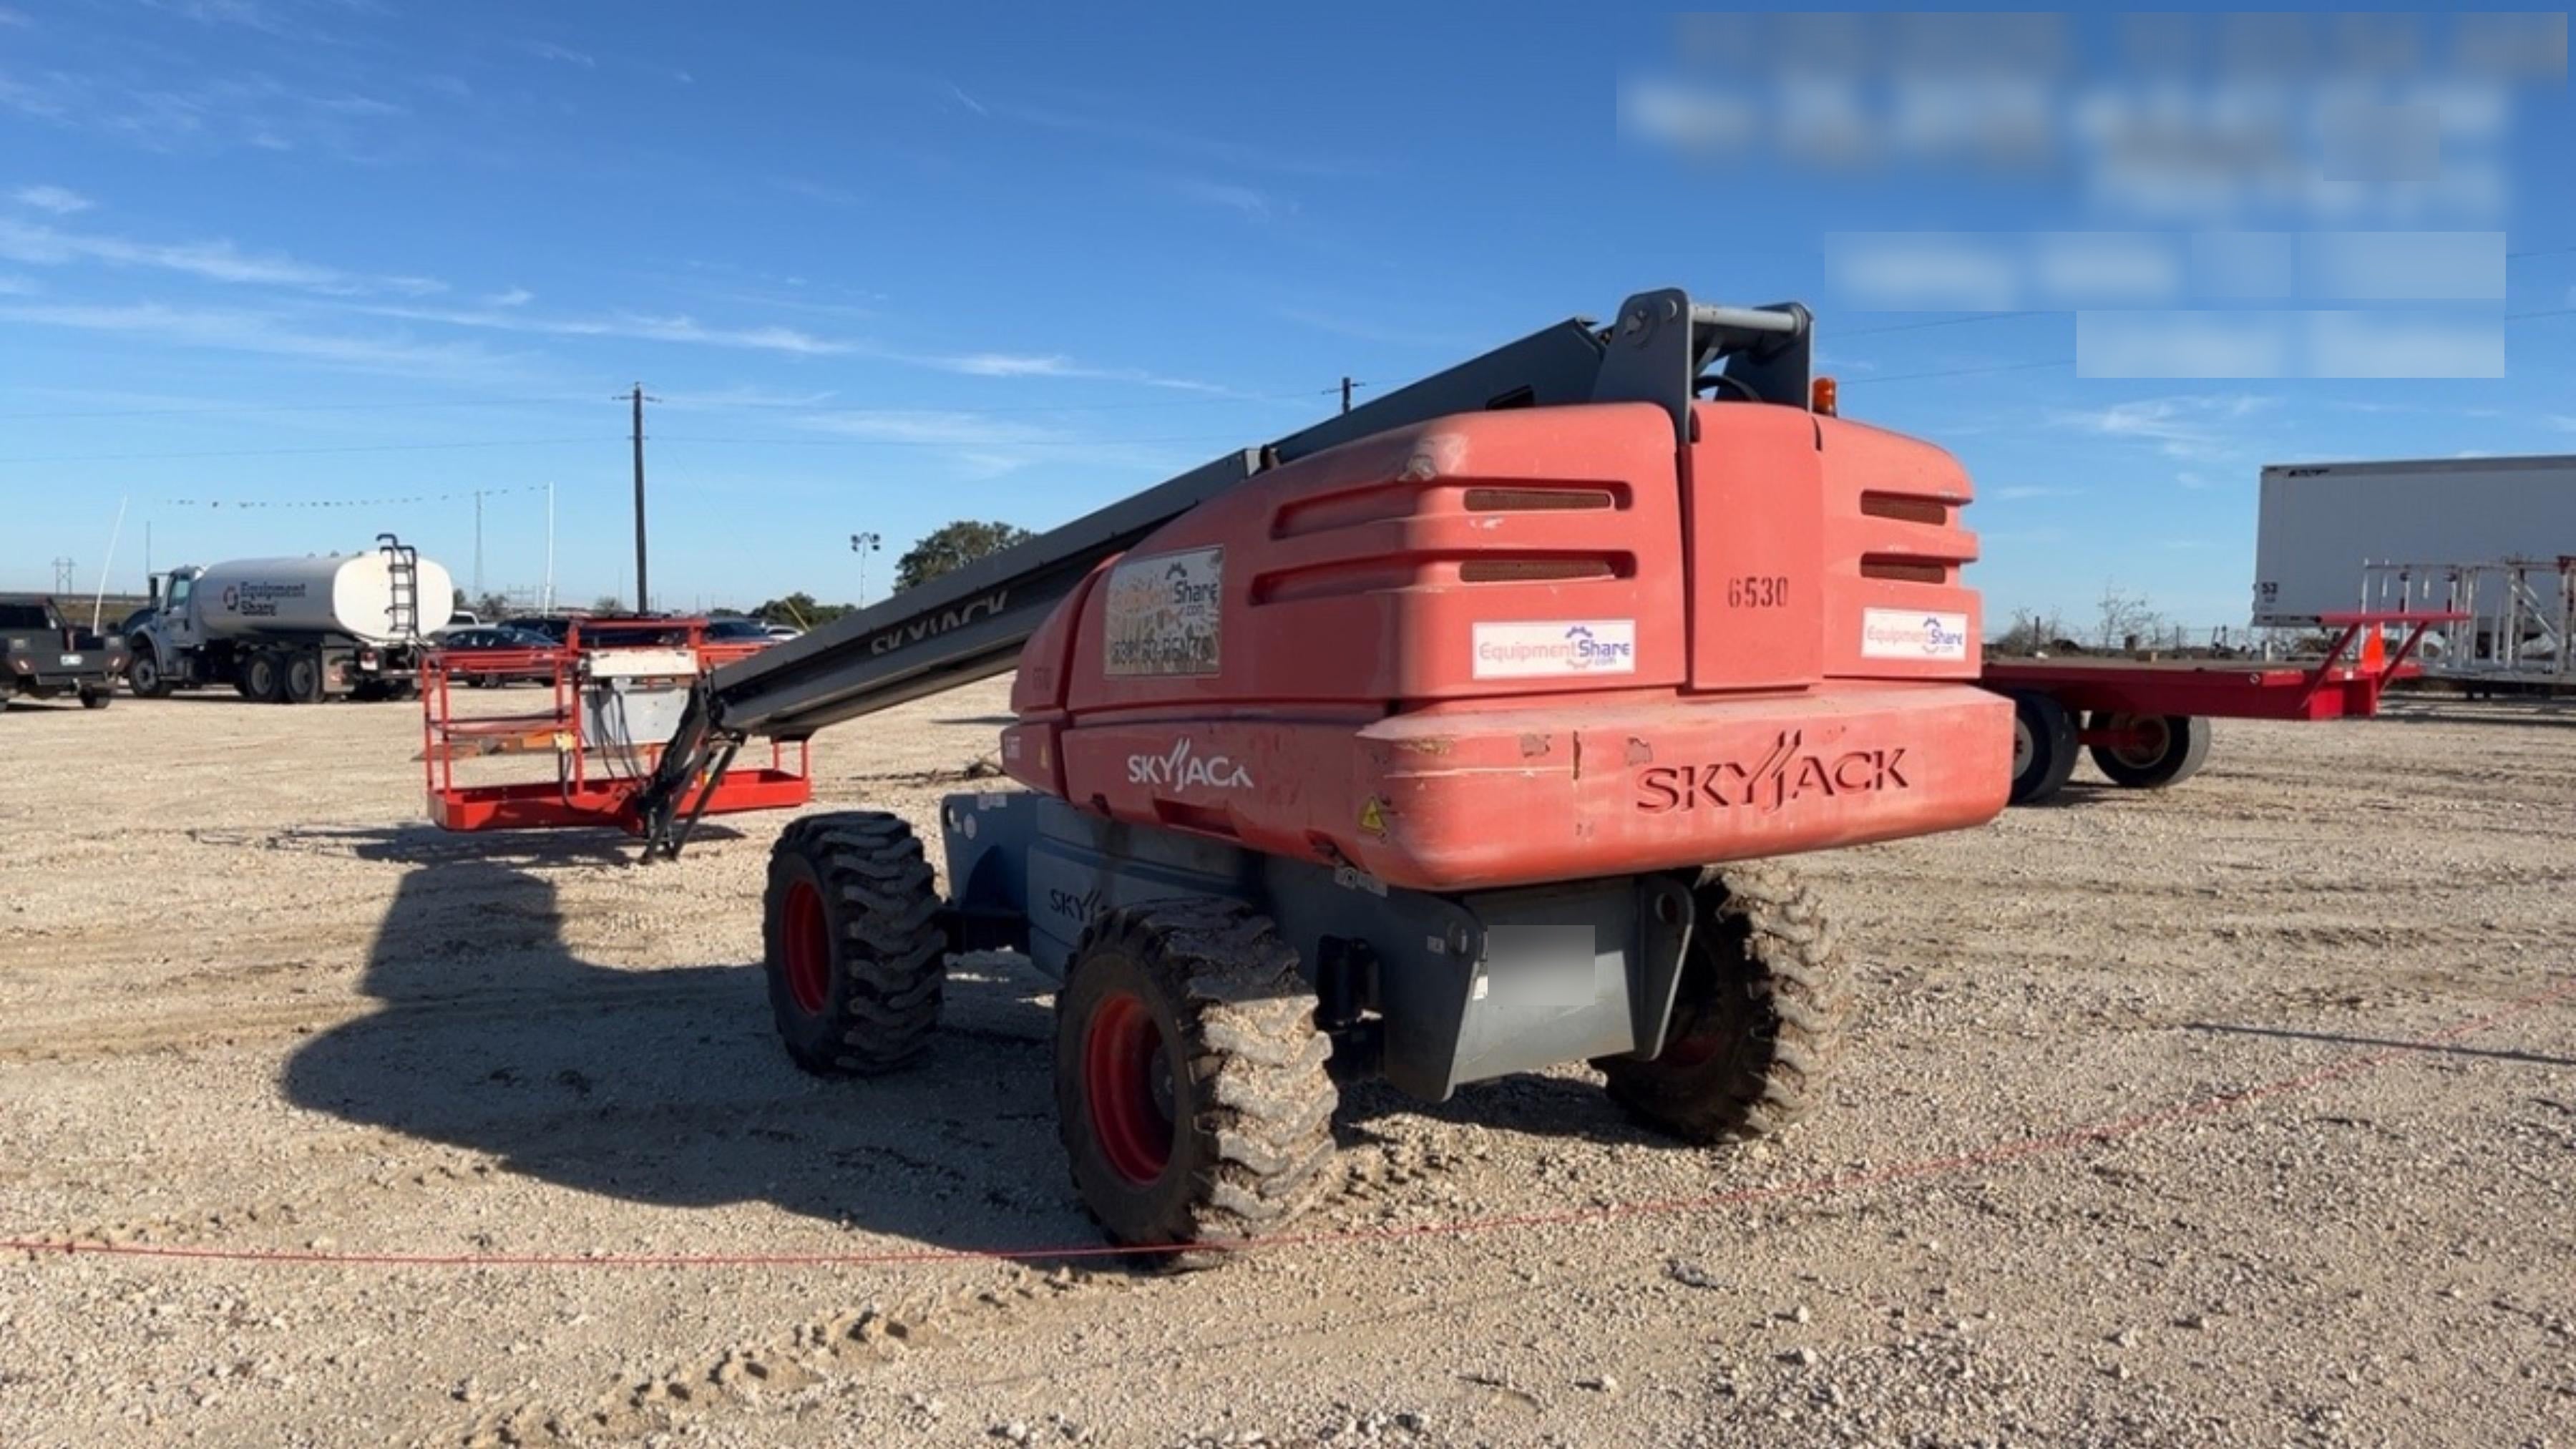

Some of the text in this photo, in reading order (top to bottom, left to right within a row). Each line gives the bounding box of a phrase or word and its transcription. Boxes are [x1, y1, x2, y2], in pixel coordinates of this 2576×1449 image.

[240, 580, 306, 600] Equipment
[1728, 577, 1789, 608] 6530
[240, 600, 276, 616] Share
[1636, 729, 1911, 814] SKYJACK
